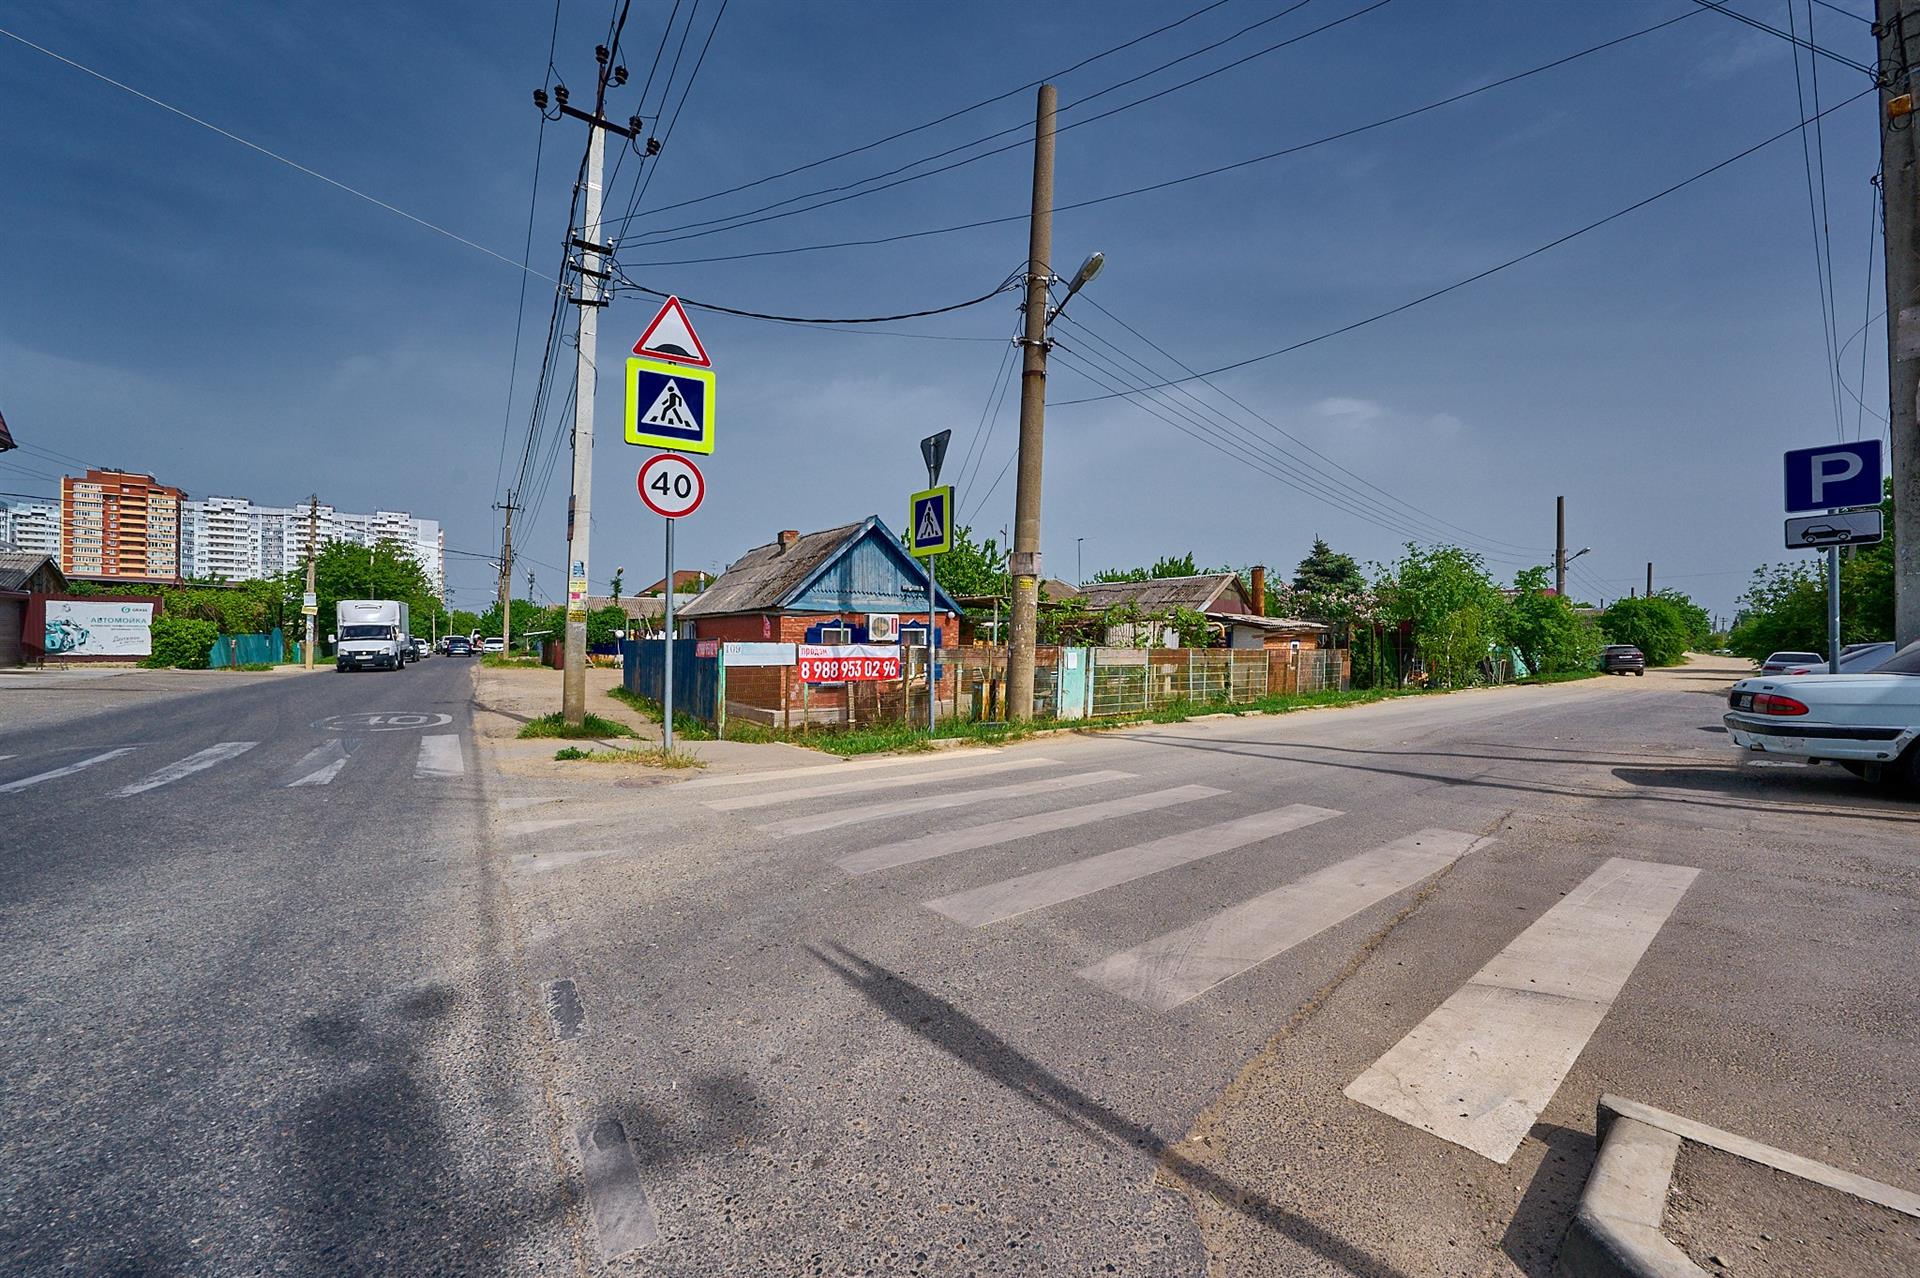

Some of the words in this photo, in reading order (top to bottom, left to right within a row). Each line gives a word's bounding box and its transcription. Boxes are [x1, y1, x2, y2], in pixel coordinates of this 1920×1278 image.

[651, 471, 692, 499] 40
[1811, 451, 1863, 503] P
[801, 661, 810, 679] 8
[813, 661, 839, 678] 988
[841, 660, 862, 677] 953
[864, 660, 880, 677] 02
[883, 660, 896, 676] 96
